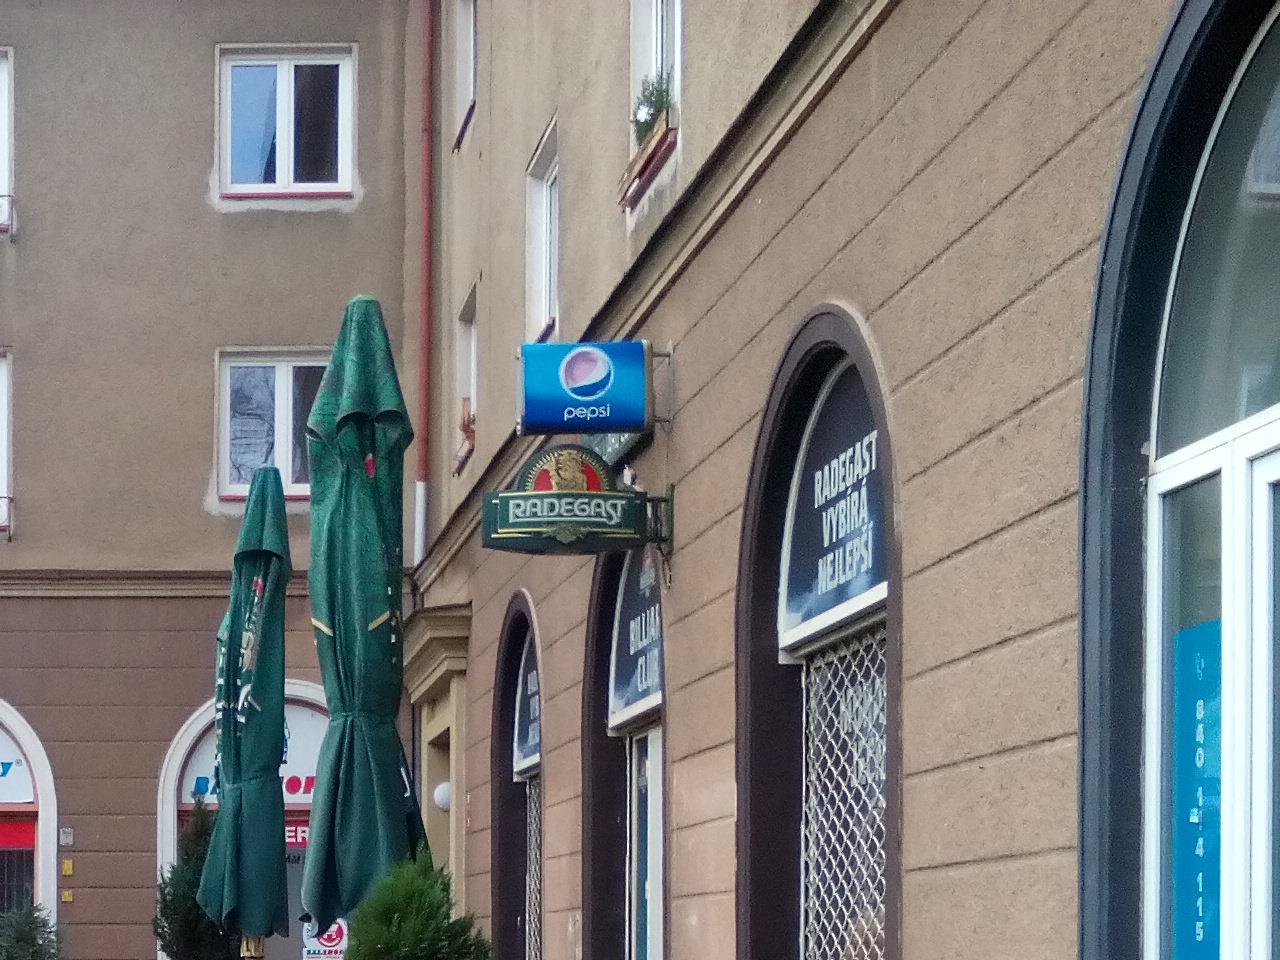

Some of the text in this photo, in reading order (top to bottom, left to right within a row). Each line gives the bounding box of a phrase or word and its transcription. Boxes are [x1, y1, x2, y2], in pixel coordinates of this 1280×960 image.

[563, 403, 610, 421] pepsi
[814, 429, 877, 509] RADEGAST
[508, 499, 626, 525] RADEGAST
[822, 477, 869, 548] VYBÍRÁ
[818, 520, 874, 596] NEJLEPŠÍ
